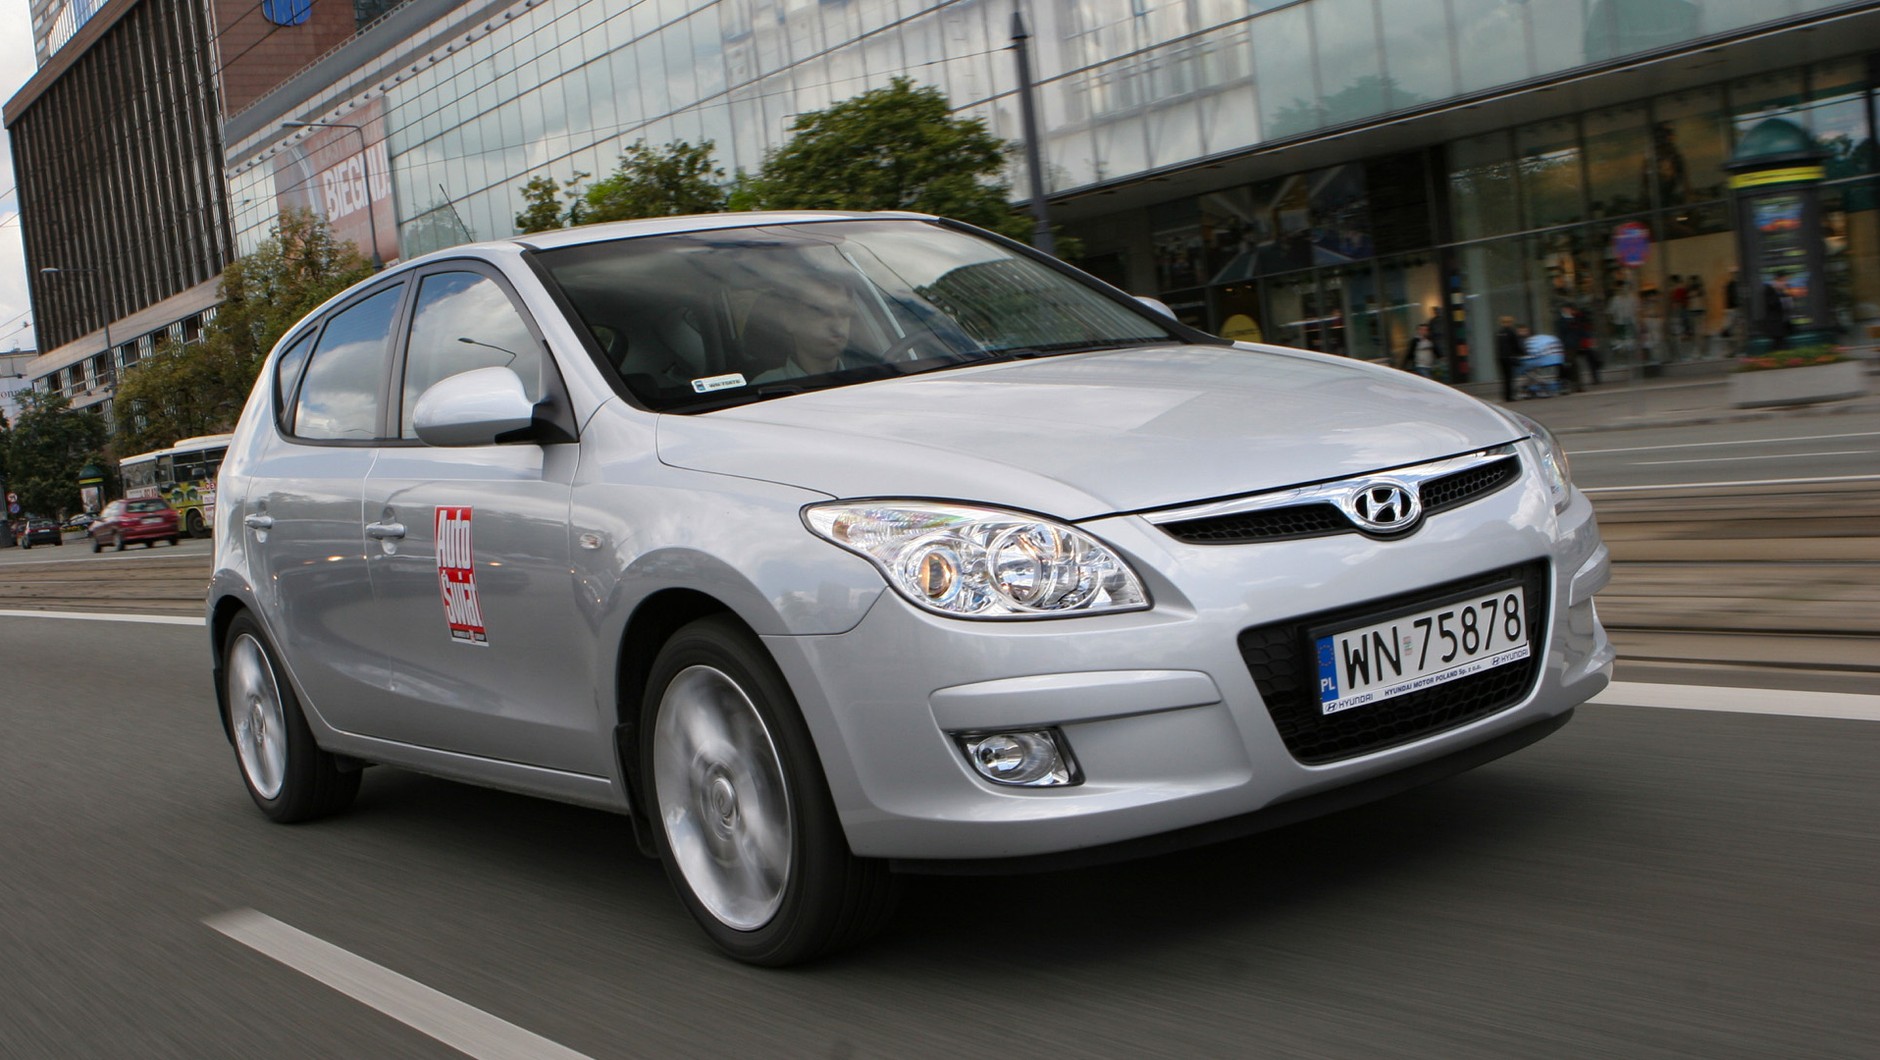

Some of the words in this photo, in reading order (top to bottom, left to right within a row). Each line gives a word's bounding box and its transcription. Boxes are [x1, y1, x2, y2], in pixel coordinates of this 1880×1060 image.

[437, 509, 471, 569] Auto
[440, 569, 483, 627] Świat
[1342, 626, 1402, 689] WN
[1413, 594, 1522, 671] 75878
[1501, 648, 1529, 663] HYUNDAI
[1320, 677, 1336, 692] PL
[1384, 684, 1412, 696] HYUNDAI
[1413, 677, 1435, 689] MOTOR
[1435, 670, 1458, 682] POLAND
[1338, 693, 1374, 709] HYUNDAI
